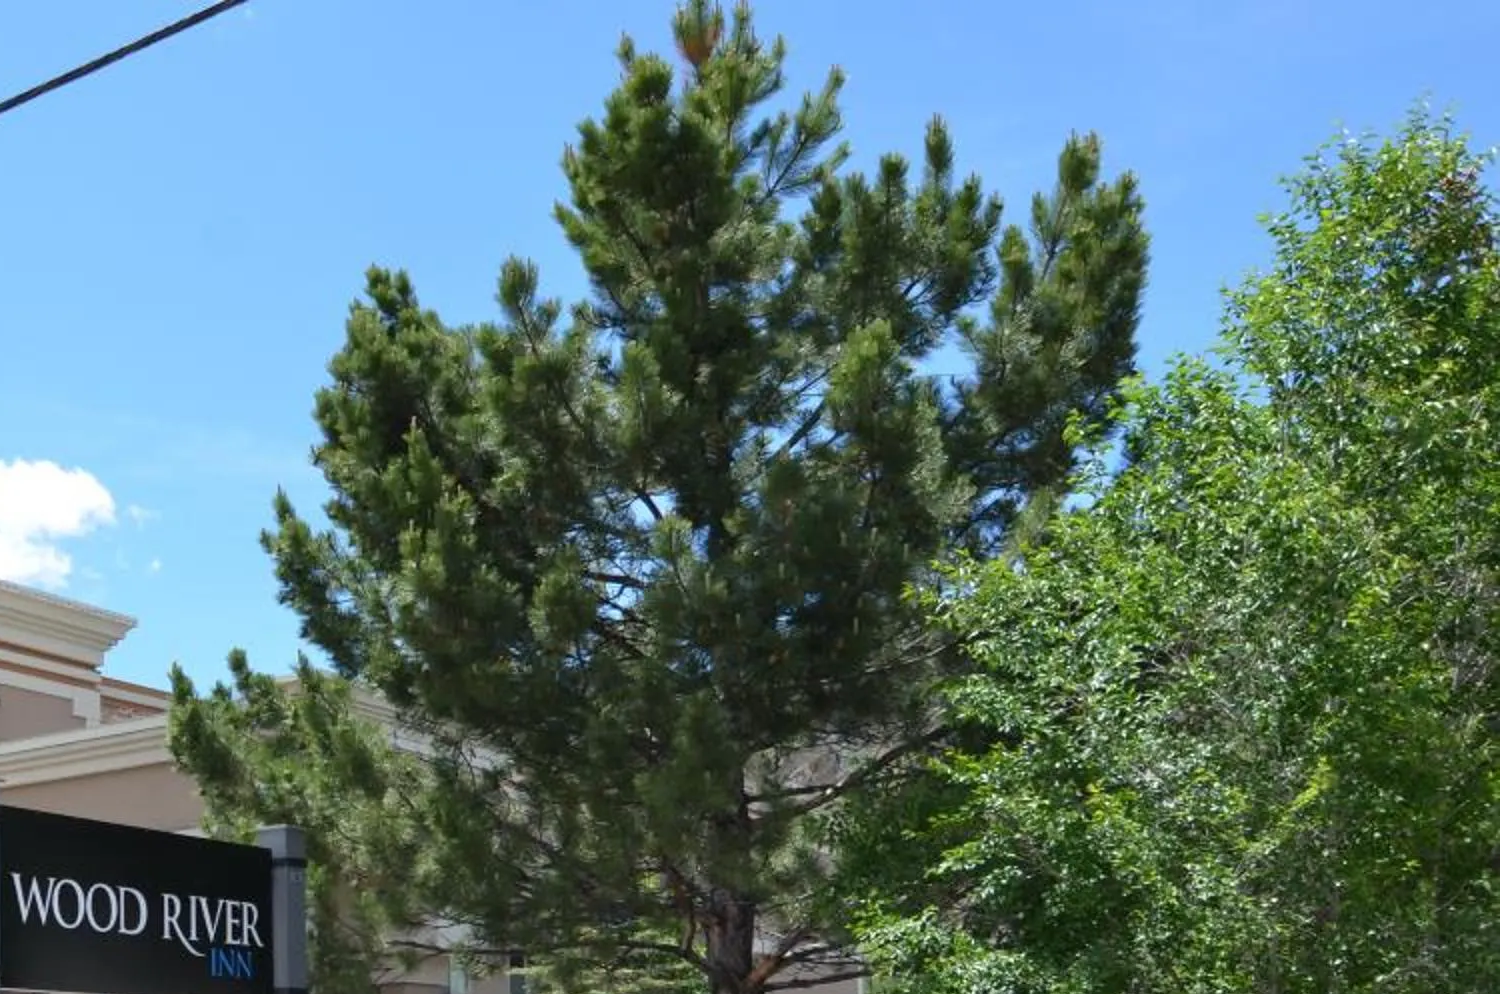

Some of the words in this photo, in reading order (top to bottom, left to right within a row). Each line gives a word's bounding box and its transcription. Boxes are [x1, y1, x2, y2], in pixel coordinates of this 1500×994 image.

[11, 872, 148, 935] WOOD
[161, 893, 264, 957] RIVER
[209, 947, 252, 977] INN
